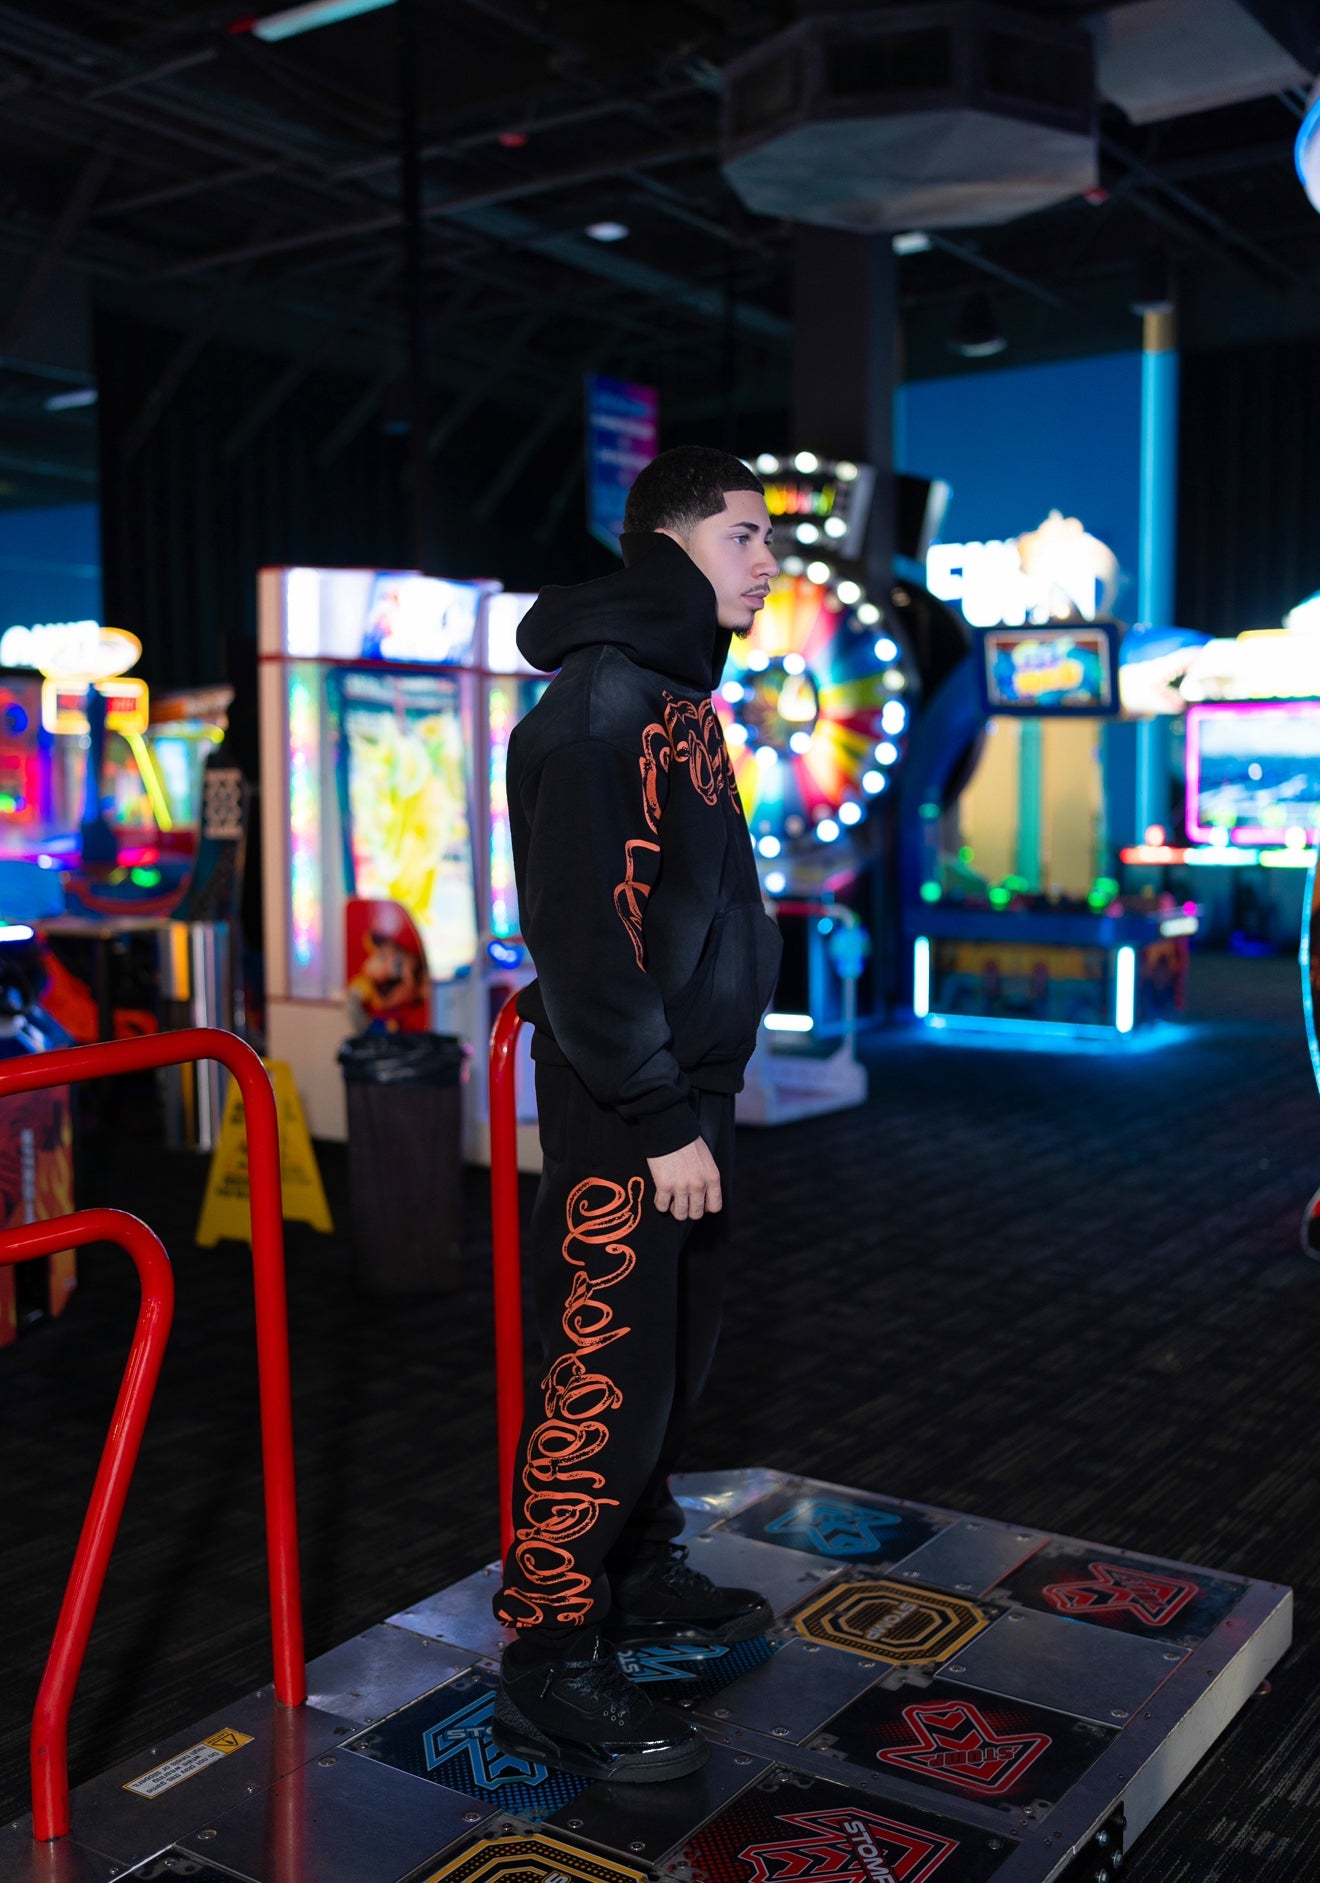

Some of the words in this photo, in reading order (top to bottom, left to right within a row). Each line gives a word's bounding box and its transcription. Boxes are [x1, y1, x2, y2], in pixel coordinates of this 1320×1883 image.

[866, 1602, 918, 1641] STOMP
[181, 1755, 200, 1767] while
[195, 1758, 209, 1766] not
[927, 1745, 1015, 1768] STOMP
[152, 1766, 181, 1783] wearing
[180, 1765, 196, 1774] play
[146, 1781, 167, 1793] game
